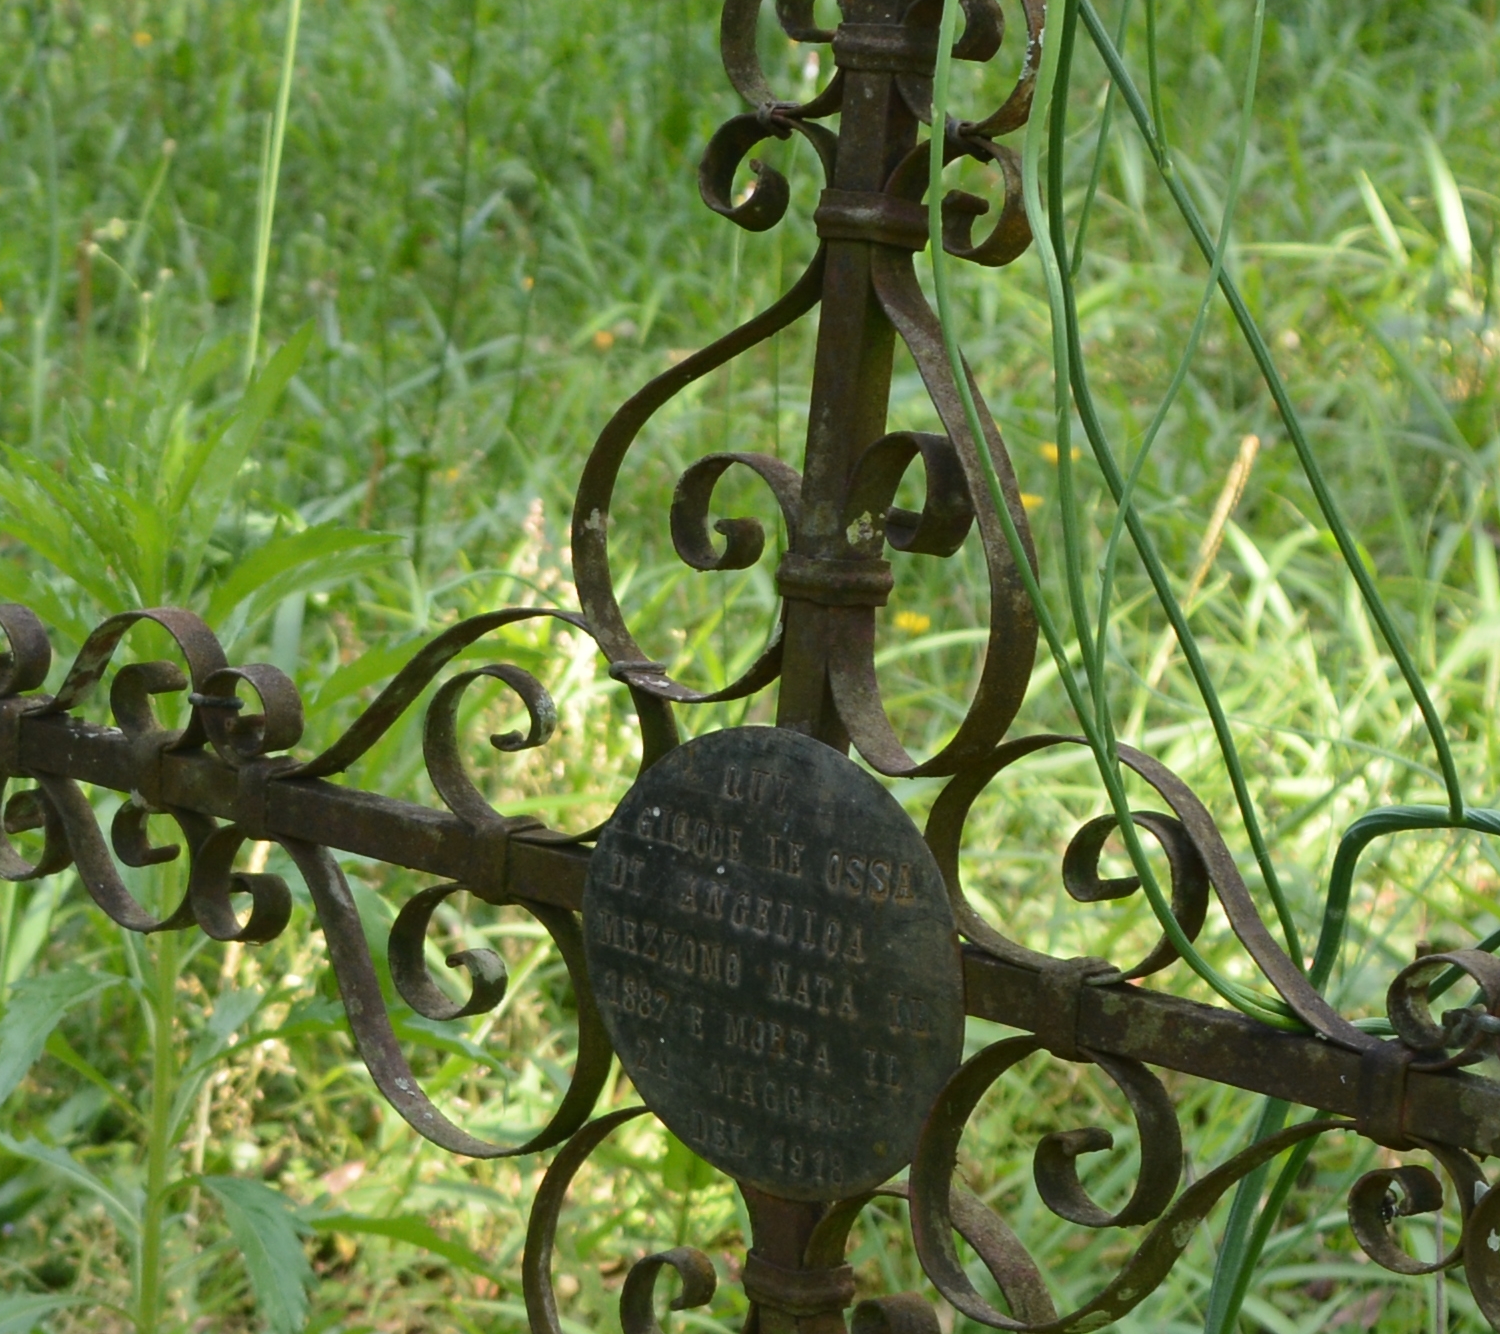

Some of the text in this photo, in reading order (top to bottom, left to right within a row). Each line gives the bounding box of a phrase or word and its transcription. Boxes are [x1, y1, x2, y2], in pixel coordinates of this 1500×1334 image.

[609, 852, 866, 964] DI ANGELICA
[826, 847, 916, 906] OSSA
[596, 908, 741, 987] MEZZOMO
[768, 958, 859, 1021] NATA
[602, 969, 670, 1023] 1887
[687, 1003, 705, 1042] E
[723, 1011, 832, 1075] MORTA
[769, 1137, 844, 1187] 1918
